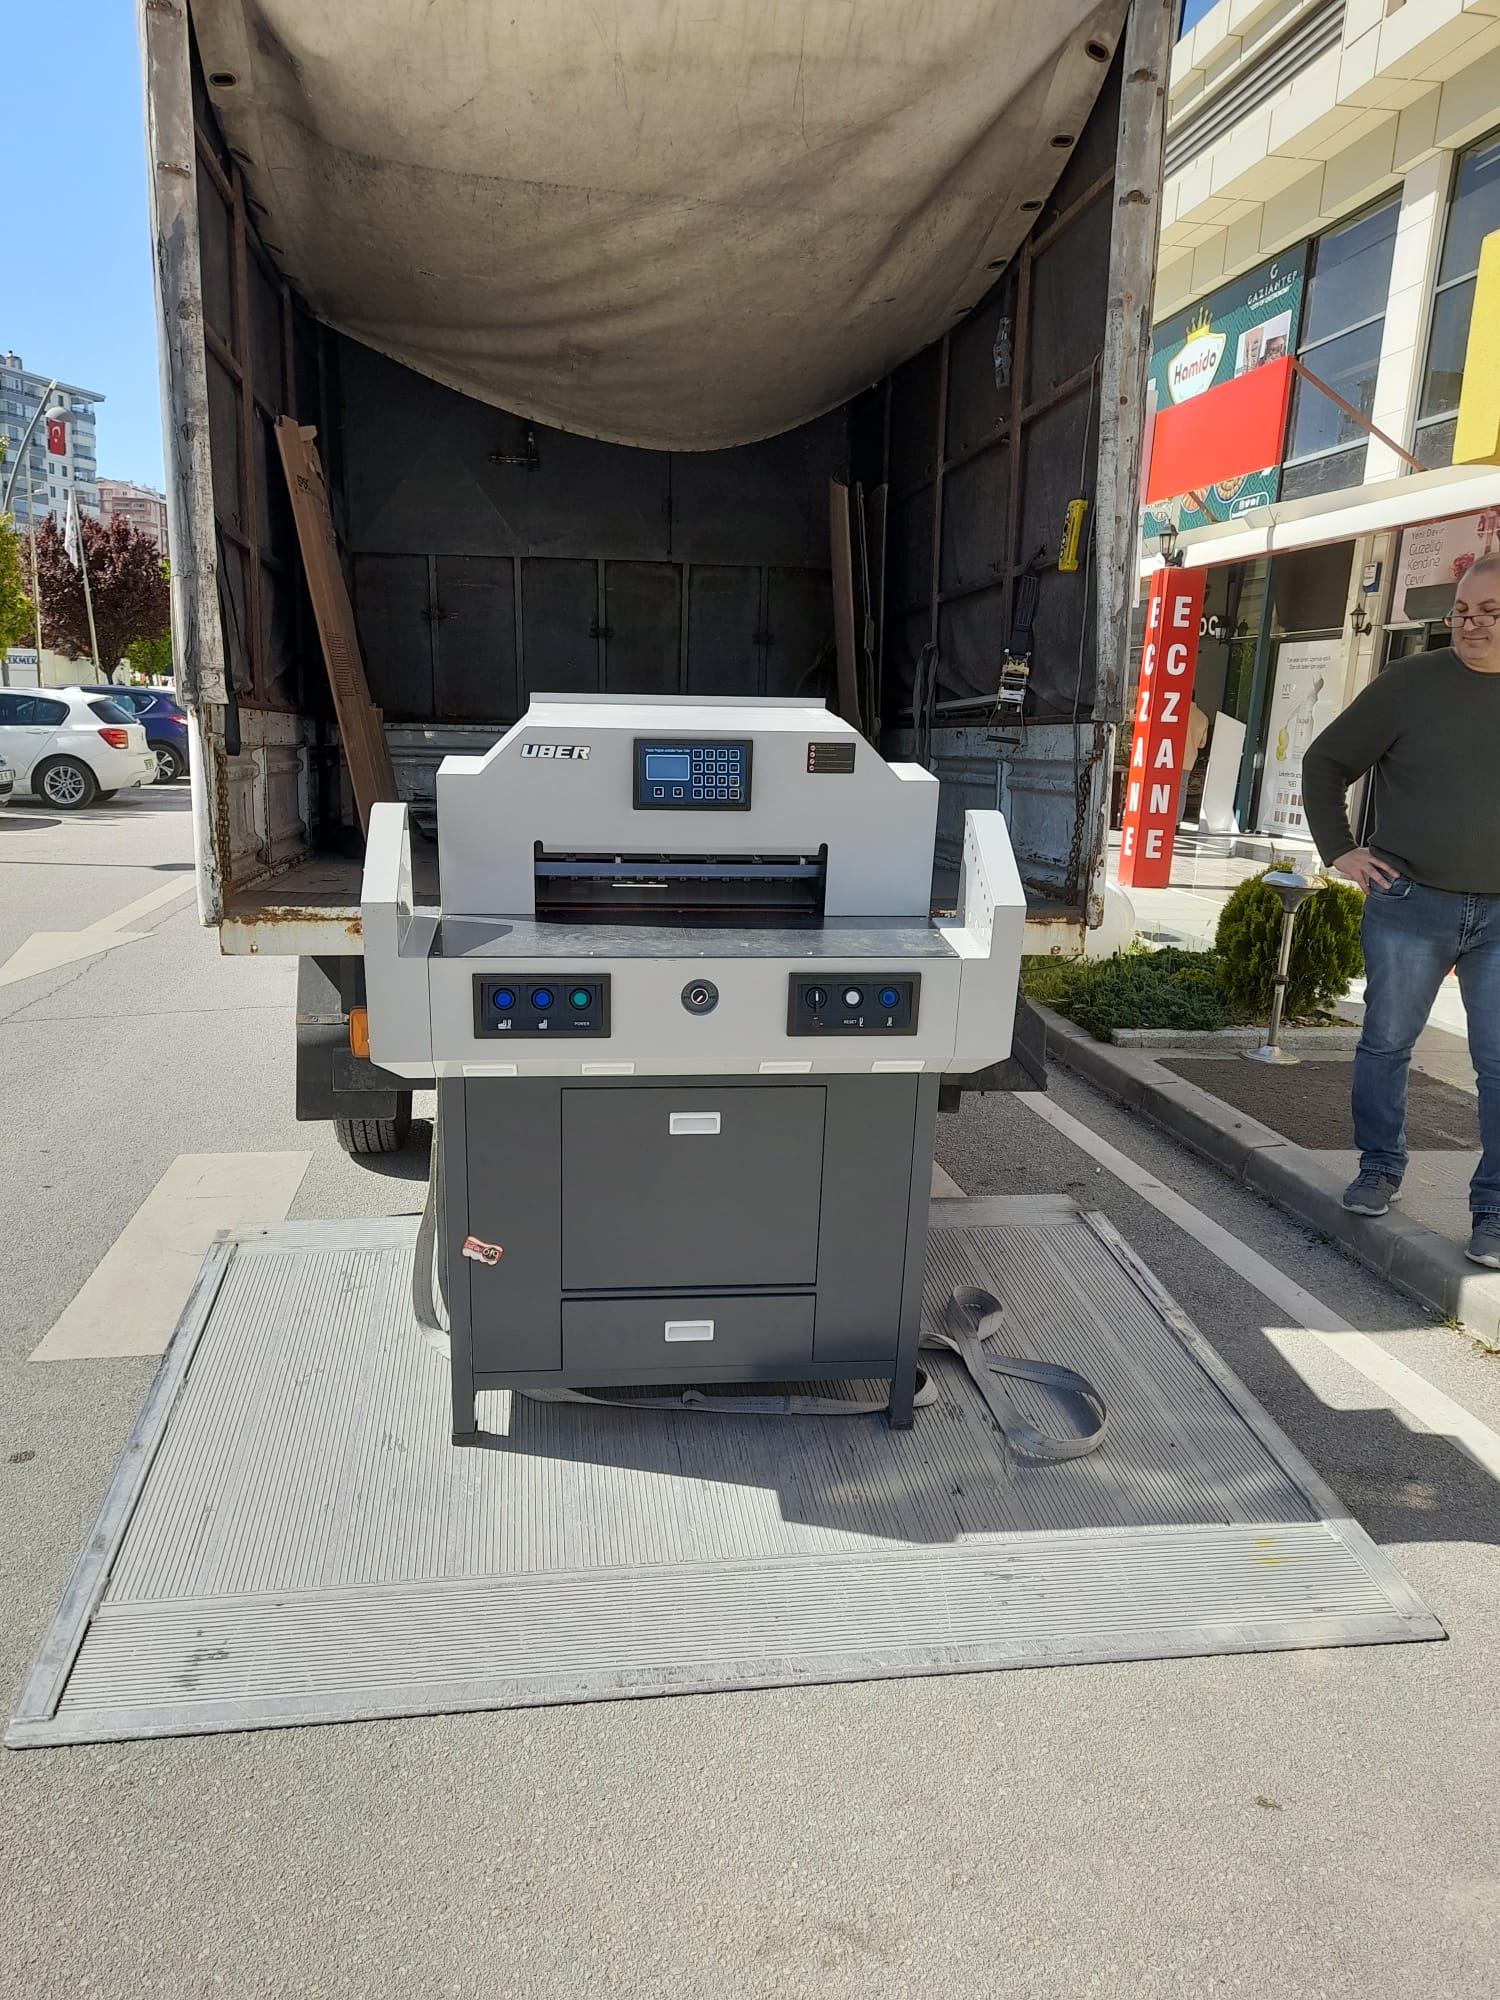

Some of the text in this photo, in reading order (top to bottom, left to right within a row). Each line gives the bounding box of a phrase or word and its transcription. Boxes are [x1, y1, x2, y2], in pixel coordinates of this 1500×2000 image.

[1173, 348, 1217, 386] Hamido
[520, 743, 592, 761] UBER
[1124, 597, 1161, 856] ECZANE
[1144, 595, 1192, 858] ECZANE
